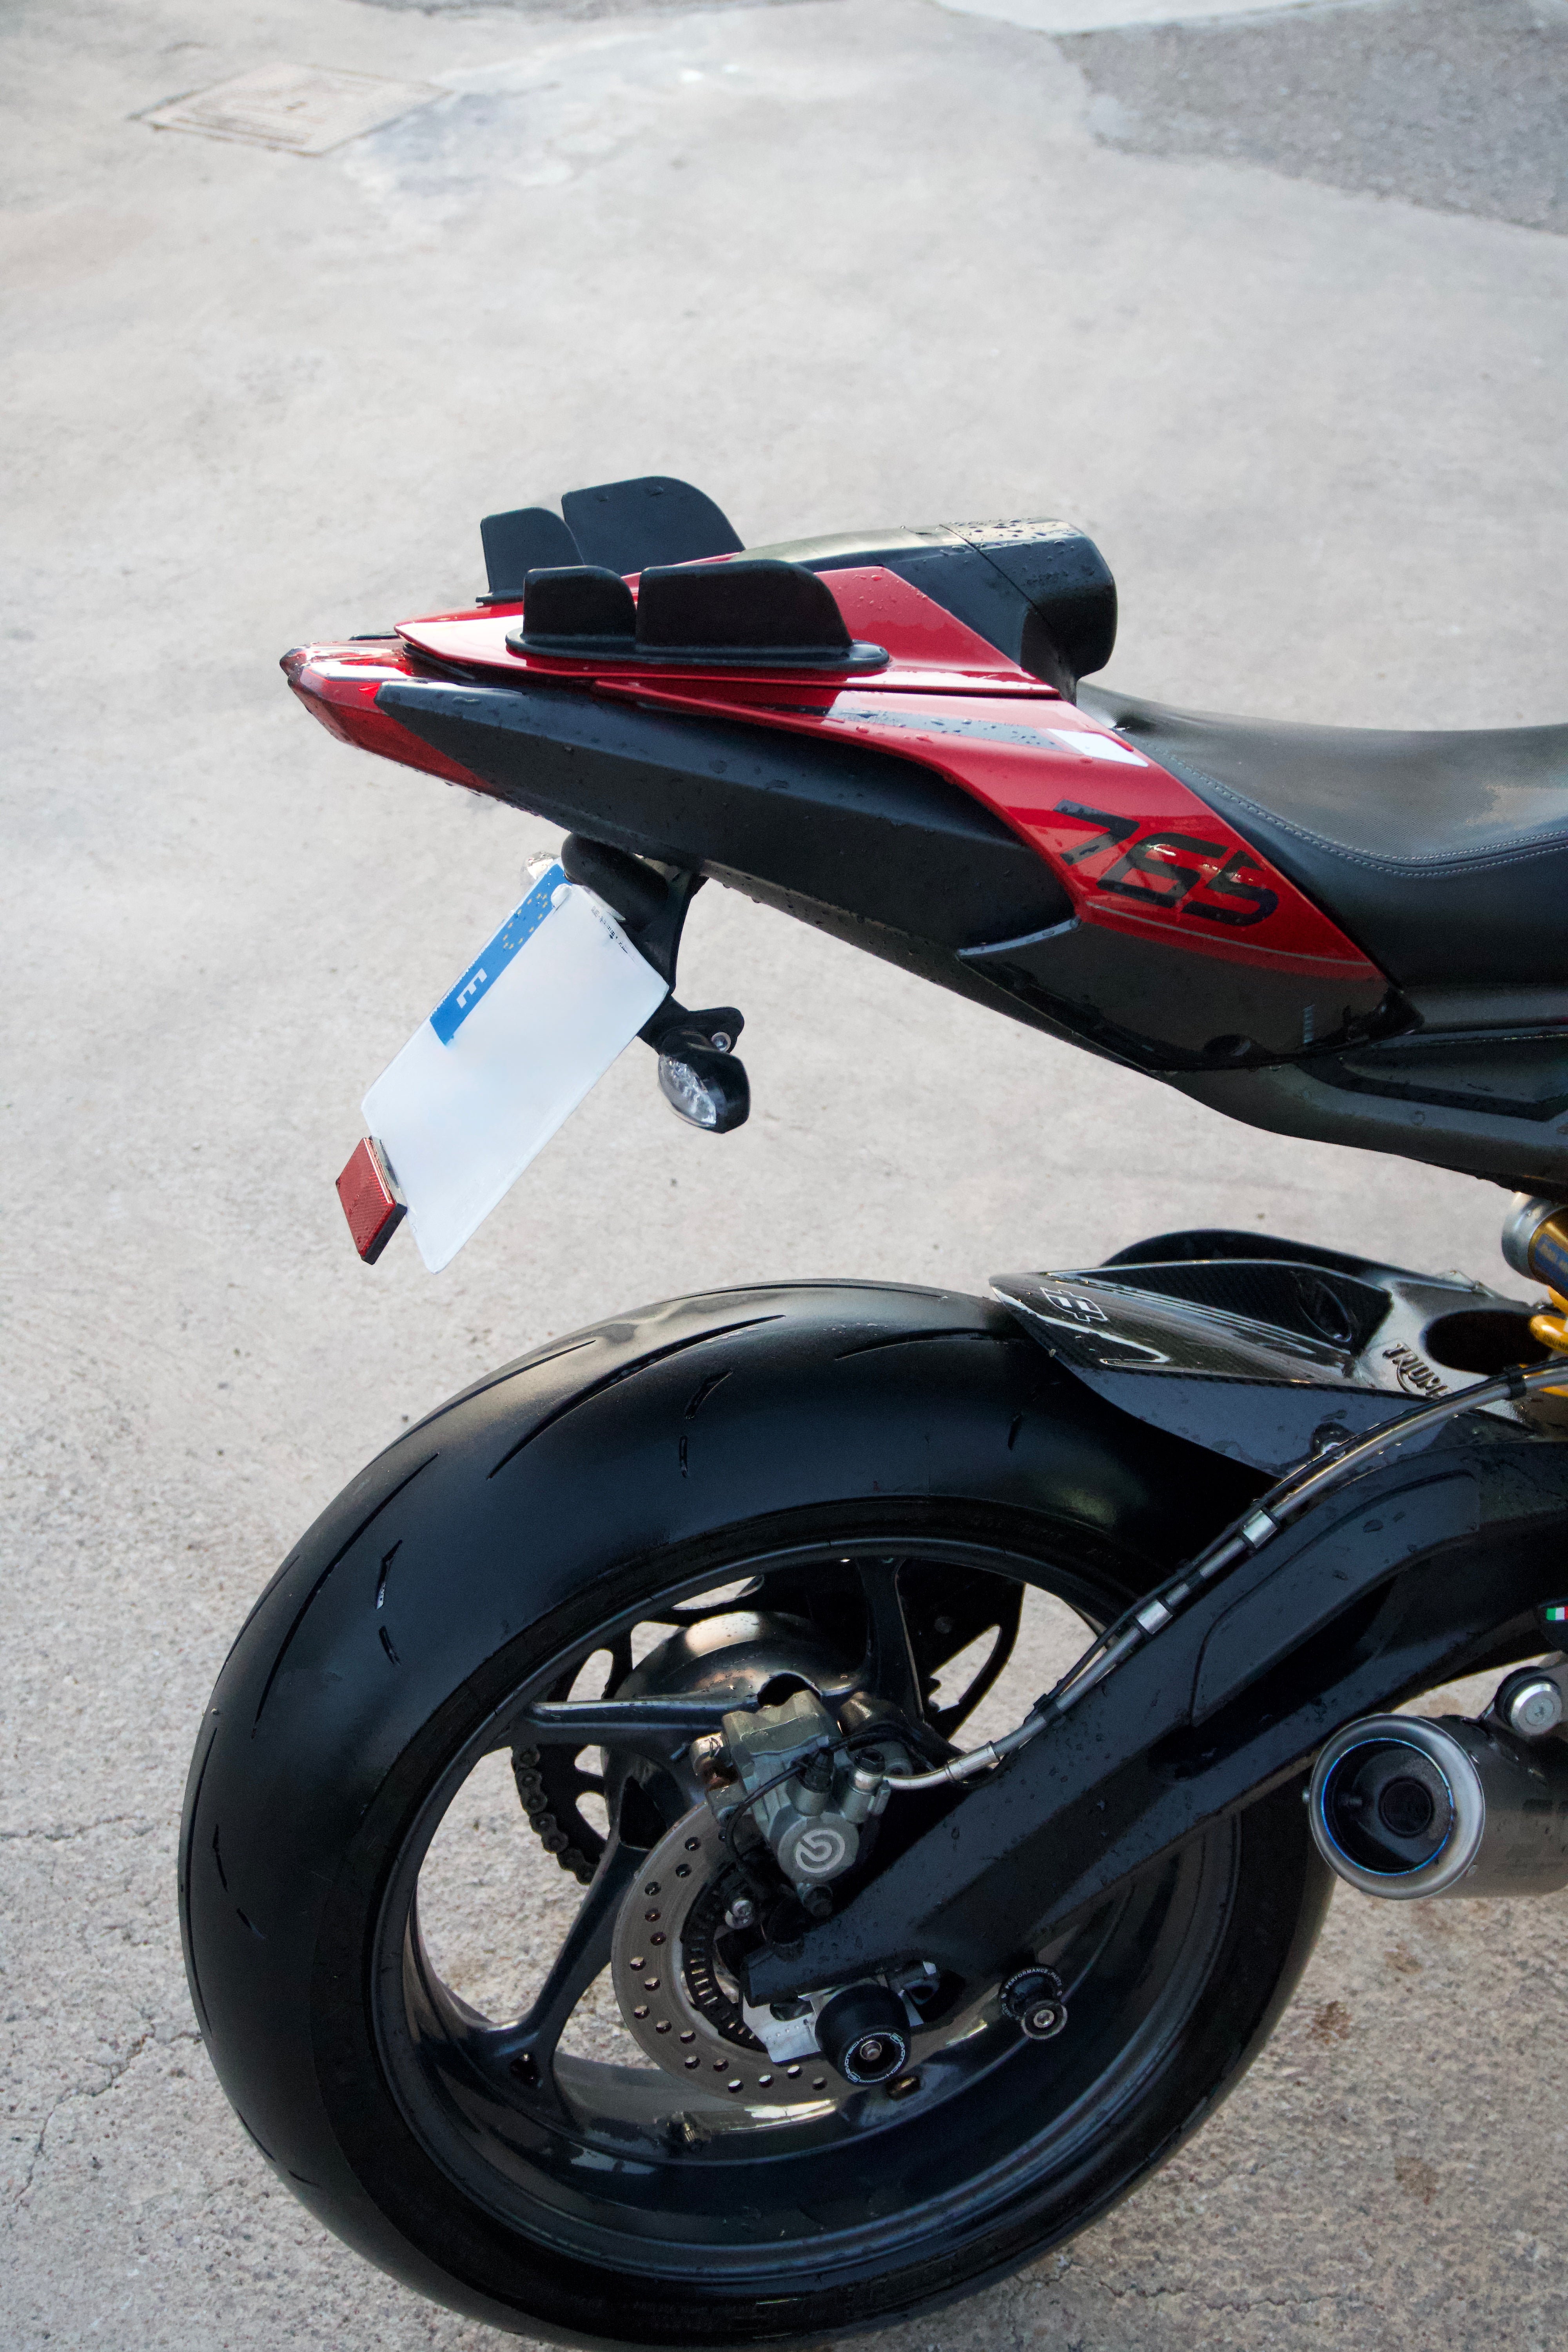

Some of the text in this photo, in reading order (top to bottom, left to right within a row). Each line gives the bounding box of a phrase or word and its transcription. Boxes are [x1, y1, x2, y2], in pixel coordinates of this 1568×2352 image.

[1053, 799, 1279, 926] 765
[456, 968, 487, 1009] E
[1382, 1342, 1454, 1399] TRIUM
[1005, 1968, 1049, 1989] PERFORMANCE
[844, 2038, 864, 2074] EVOTECH
[886, 2042, 906, 2076] EVOTECH
